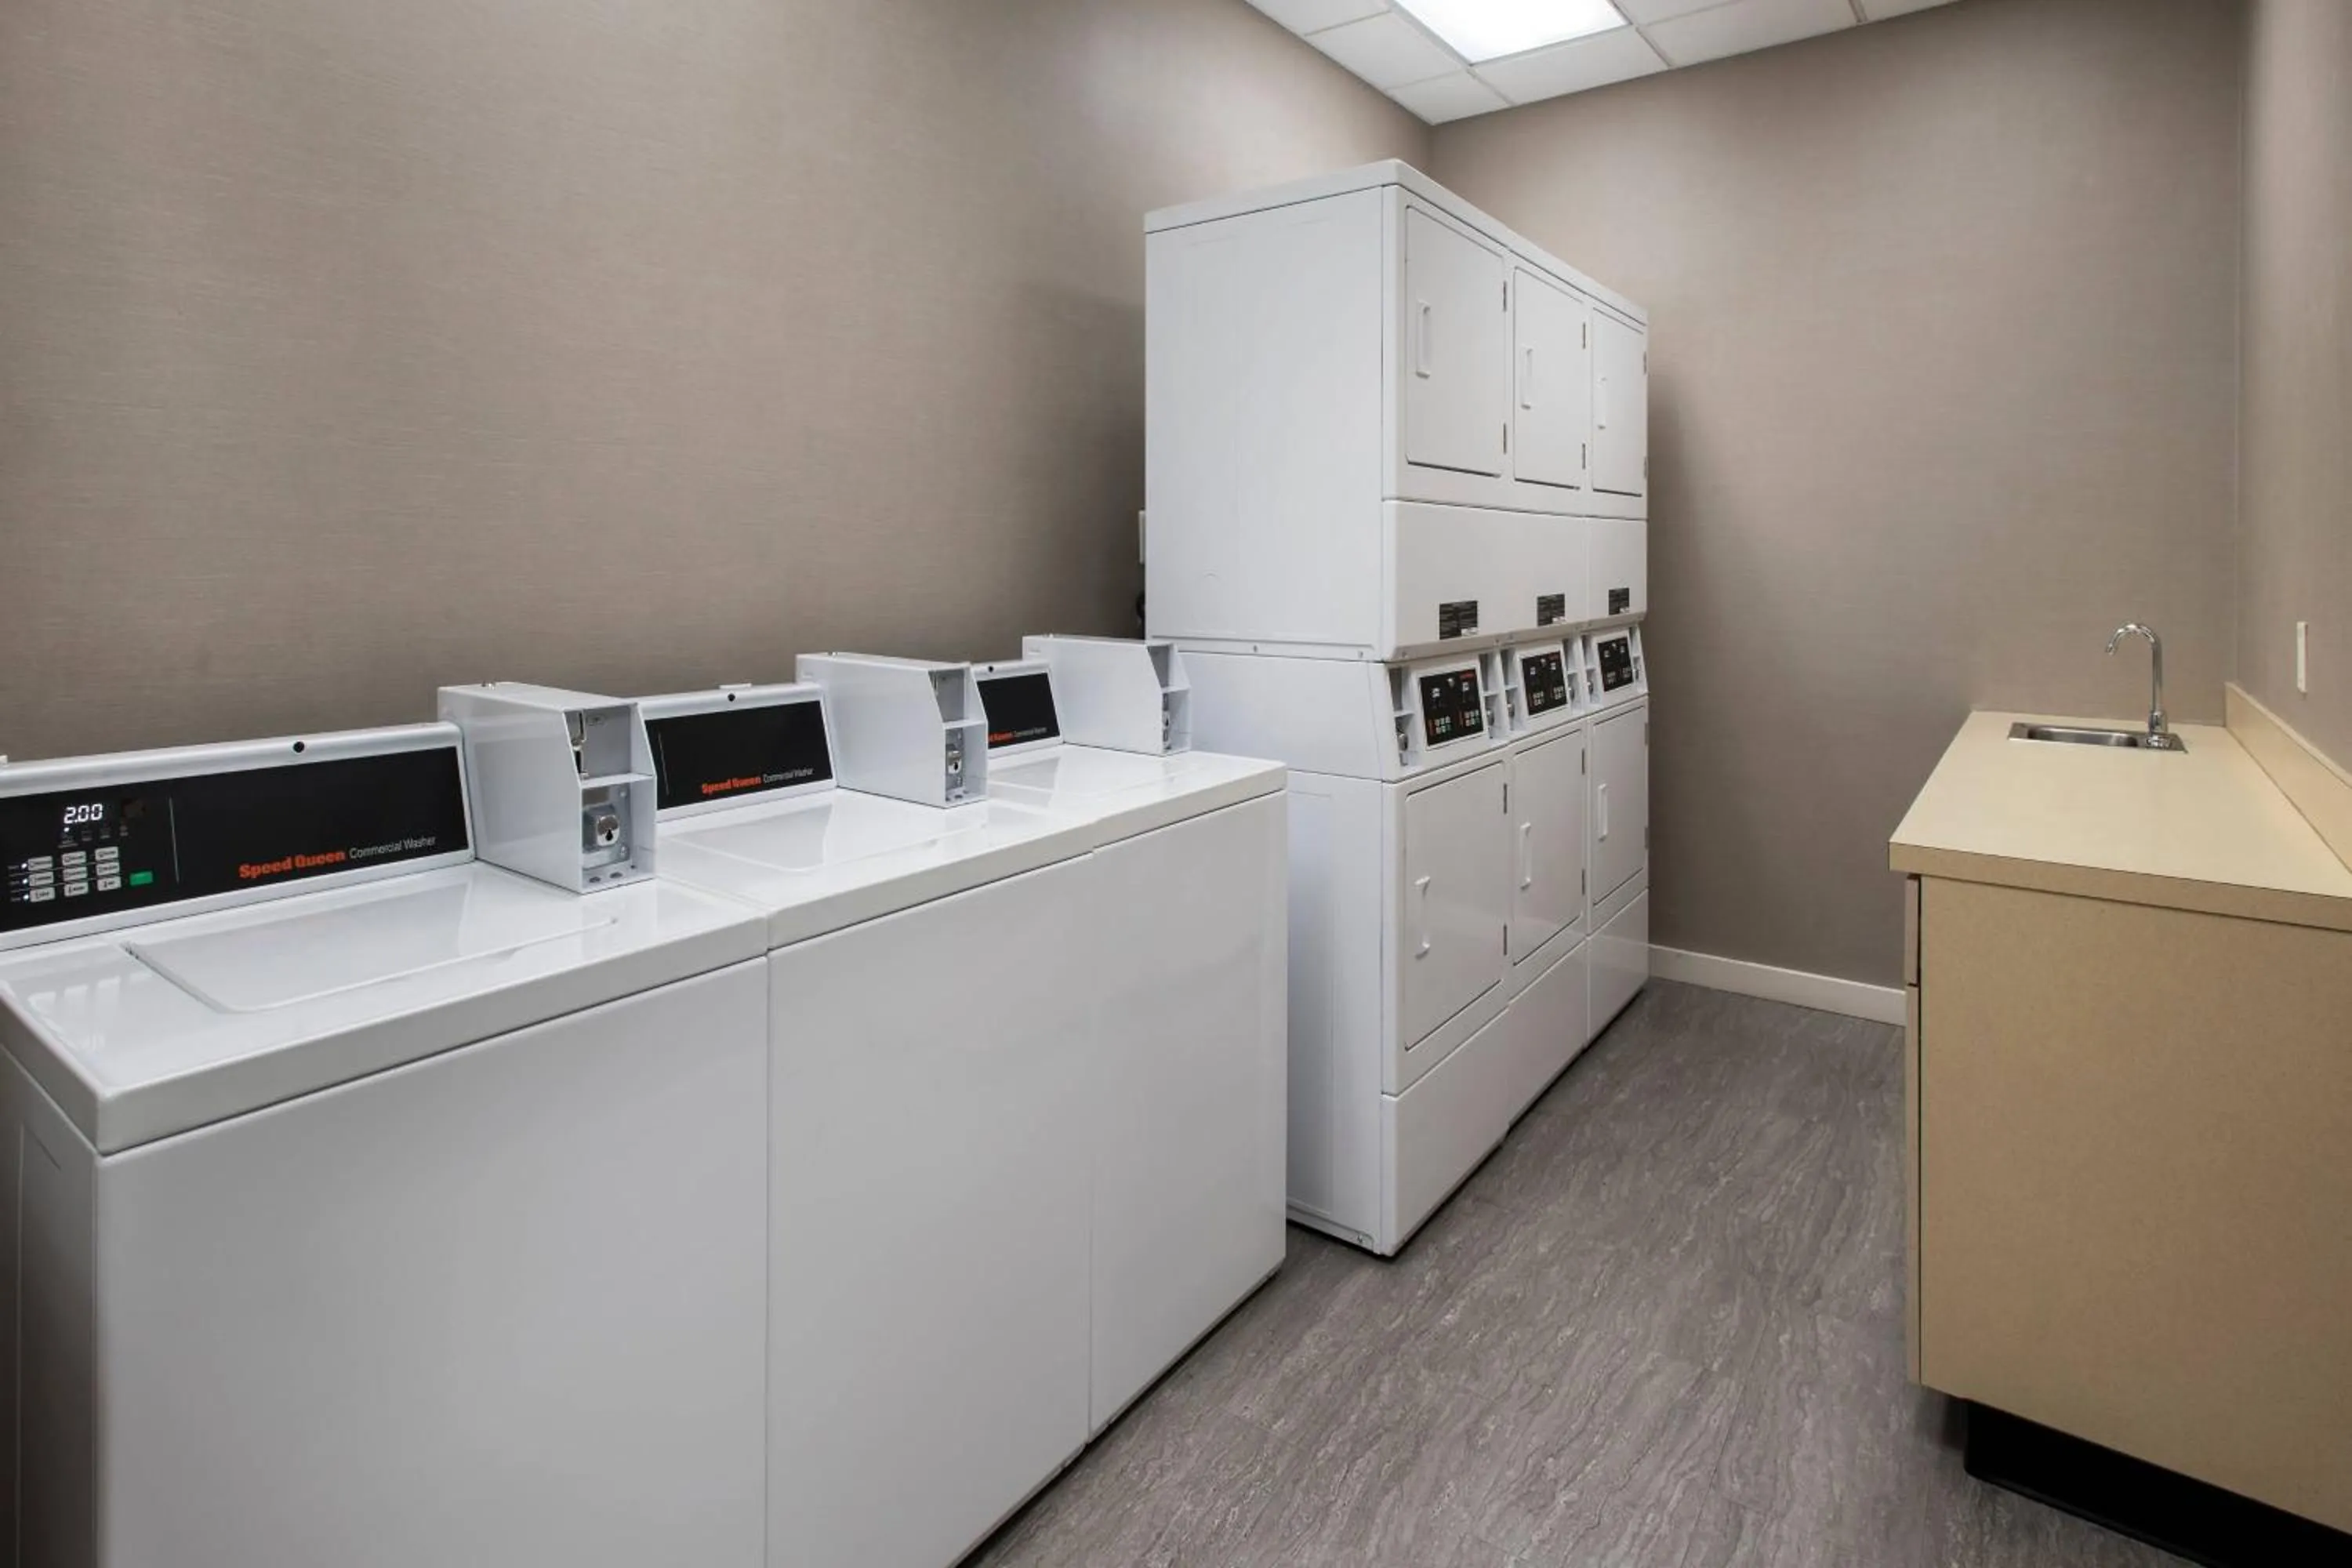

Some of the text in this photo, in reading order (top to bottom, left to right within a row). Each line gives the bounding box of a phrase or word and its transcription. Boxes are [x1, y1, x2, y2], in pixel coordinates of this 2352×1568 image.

[64, 803, 103, 824] 2.00
[238, 836, 436, 879] Speed Queen Commercial Washer
